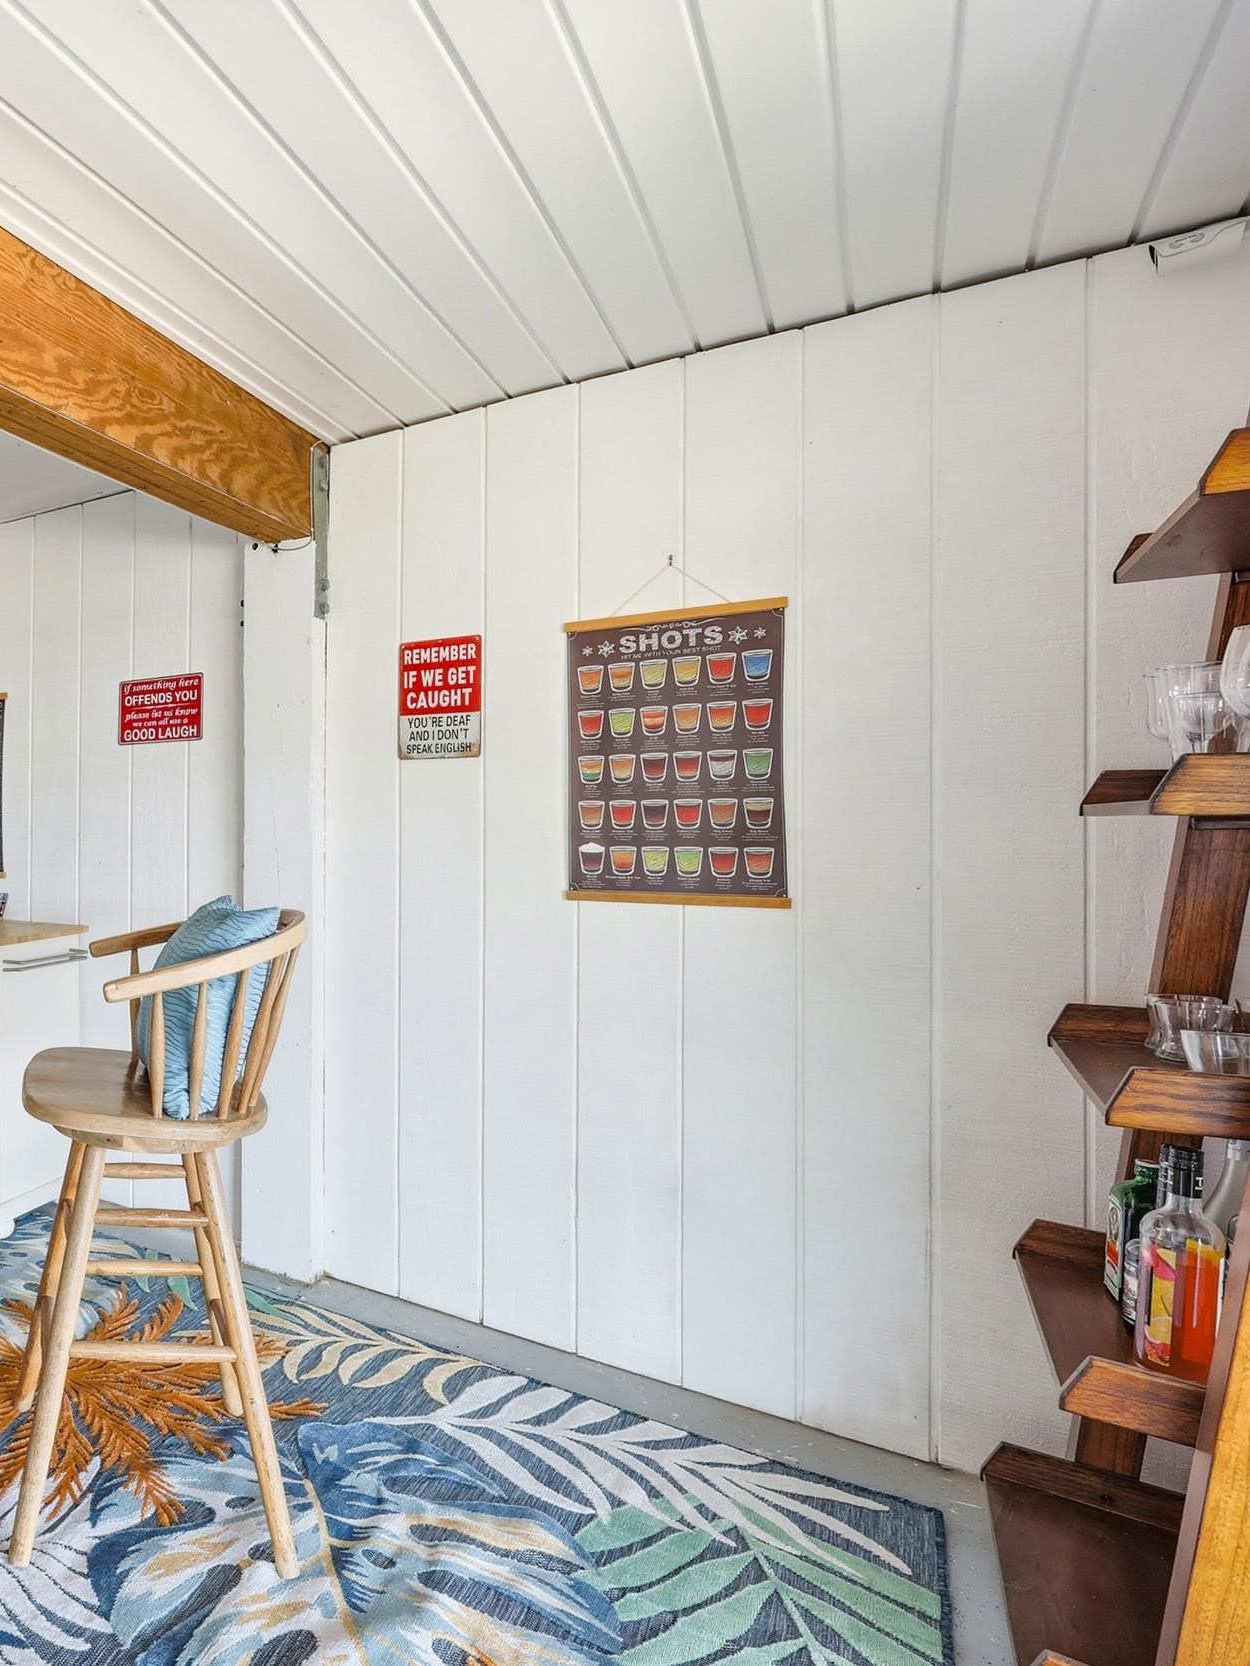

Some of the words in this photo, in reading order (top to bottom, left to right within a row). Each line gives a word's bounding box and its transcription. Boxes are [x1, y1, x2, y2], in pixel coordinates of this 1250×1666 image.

[619, 625, 723, 653] SHOTS
[404, 643, 477, 665] REMEMBER
[404, 670, 417, 688] IF
[421, 668, 444, 687] WE
[447, 666, 476, 686] GET
[124, 692, 173, 706] OFFENDS
[174, 689, 198, 702] YOU
[406, 688, 472, 709] CAUGHT
[407, 716, 444, 728] YOU'RE
[446, 715, 471, 727] DEAF
[124, 728, 156, 741] GOOD
[158, 725, 197, 739] LAUGH
[409, 730, 430, 741] AND
[437, 728, 469, 740] DON'T
[406, 744, 434, 755] SPEAK
[434, 742, 472, 754] ENGLISH
